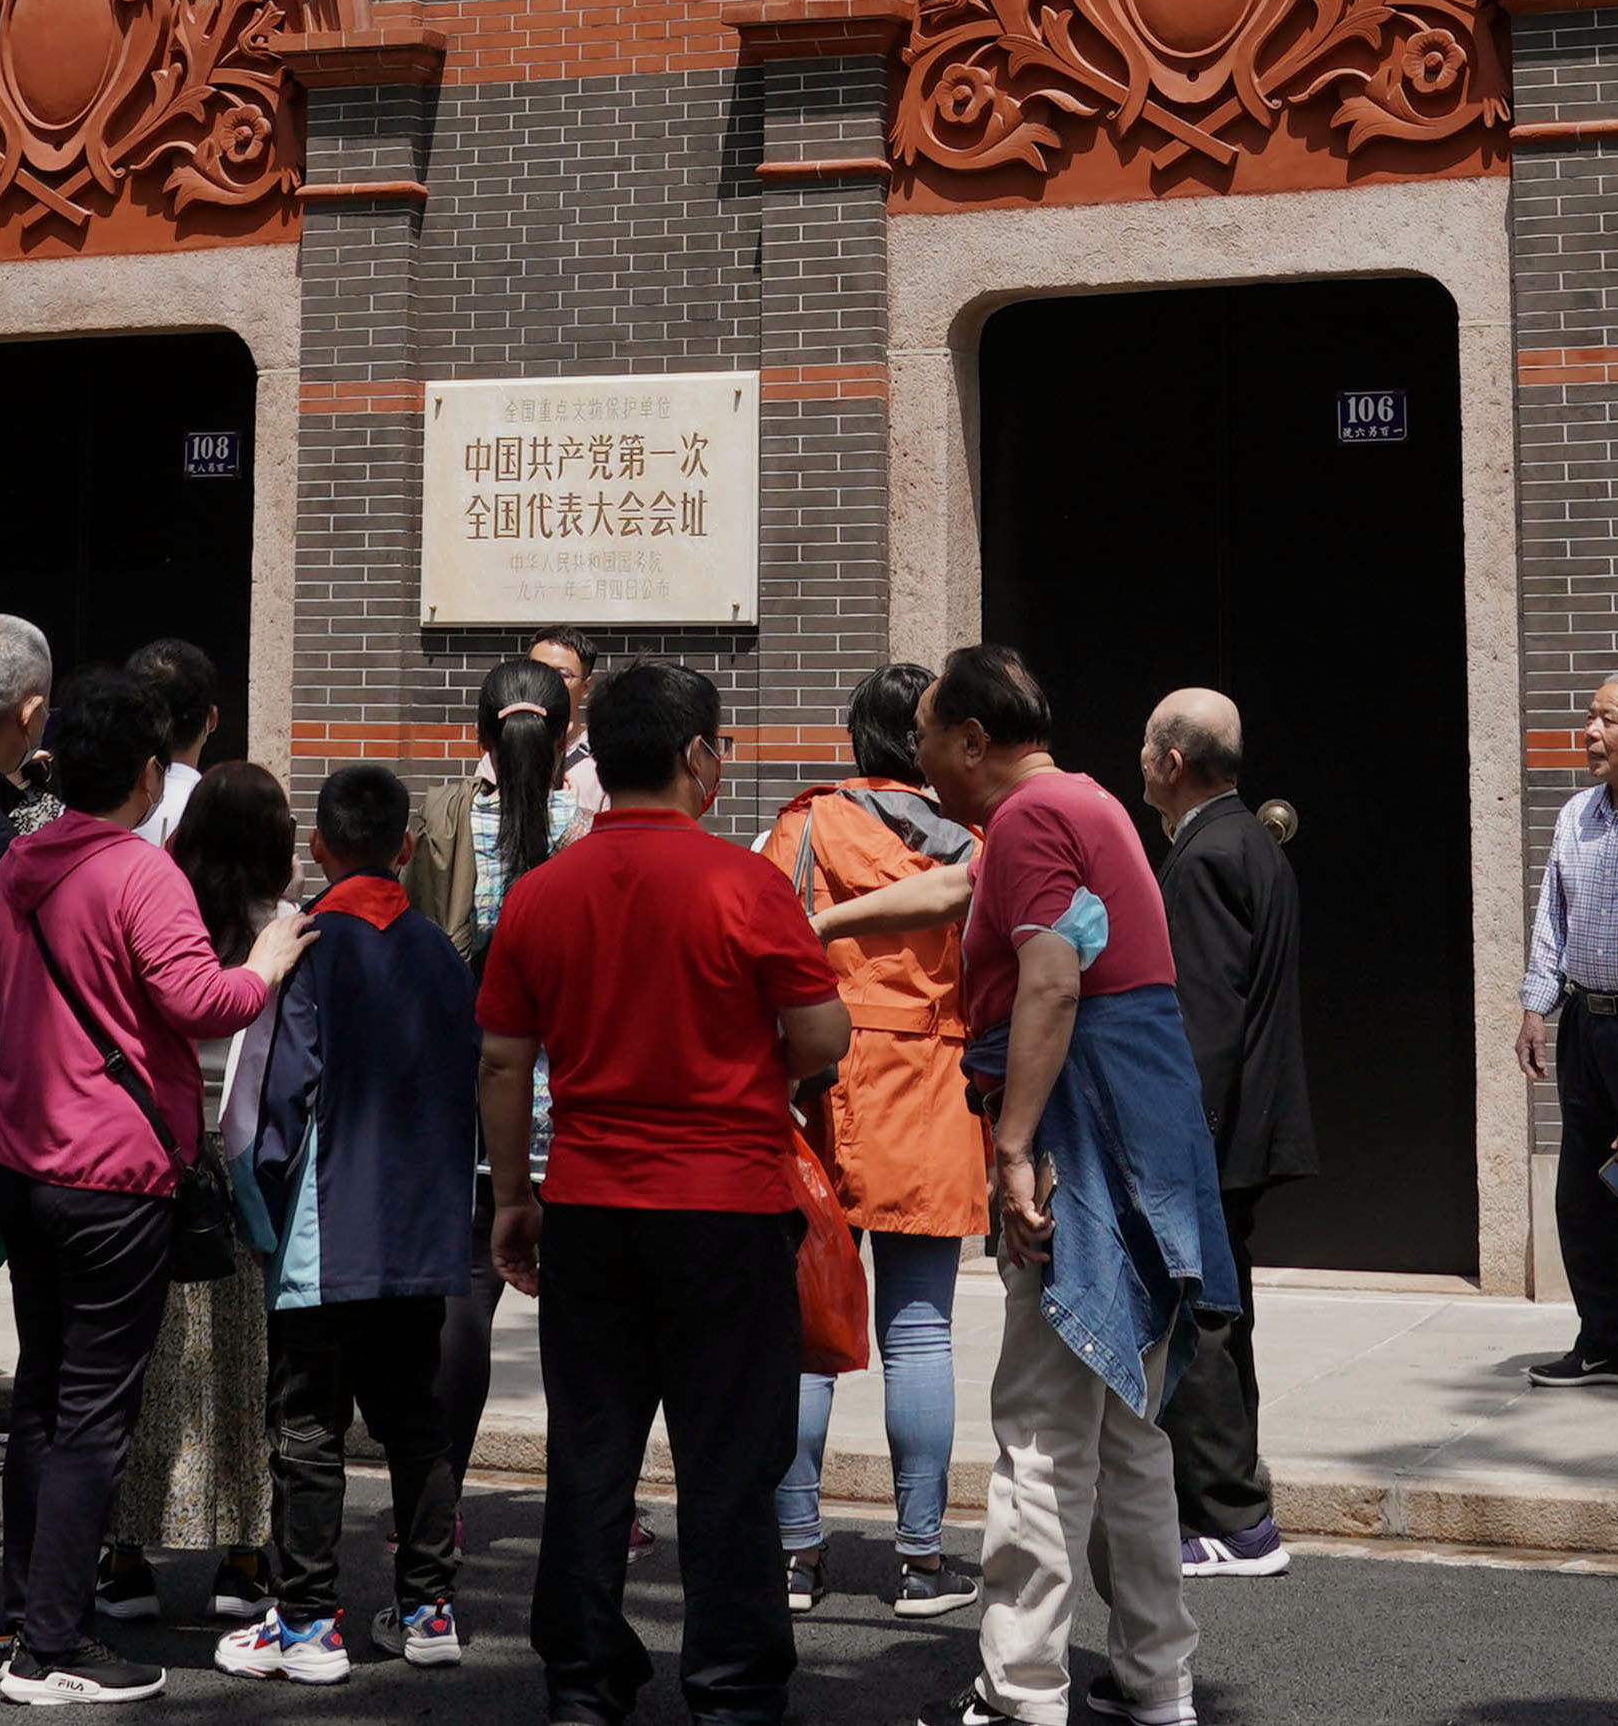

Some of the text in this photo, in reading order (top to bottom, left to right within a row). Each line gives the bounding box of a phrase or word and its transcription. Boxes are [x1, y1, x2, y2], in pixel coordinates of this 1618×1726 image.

[1347, 395, 1394, 423] 106
[192, 435, 230, 460] 108
[464, 431, 710, 483] 中国共产党第一次
[464, 489, 709, 541] 全国代表大会会址
[57, 1678, 84, 1692] FILA
